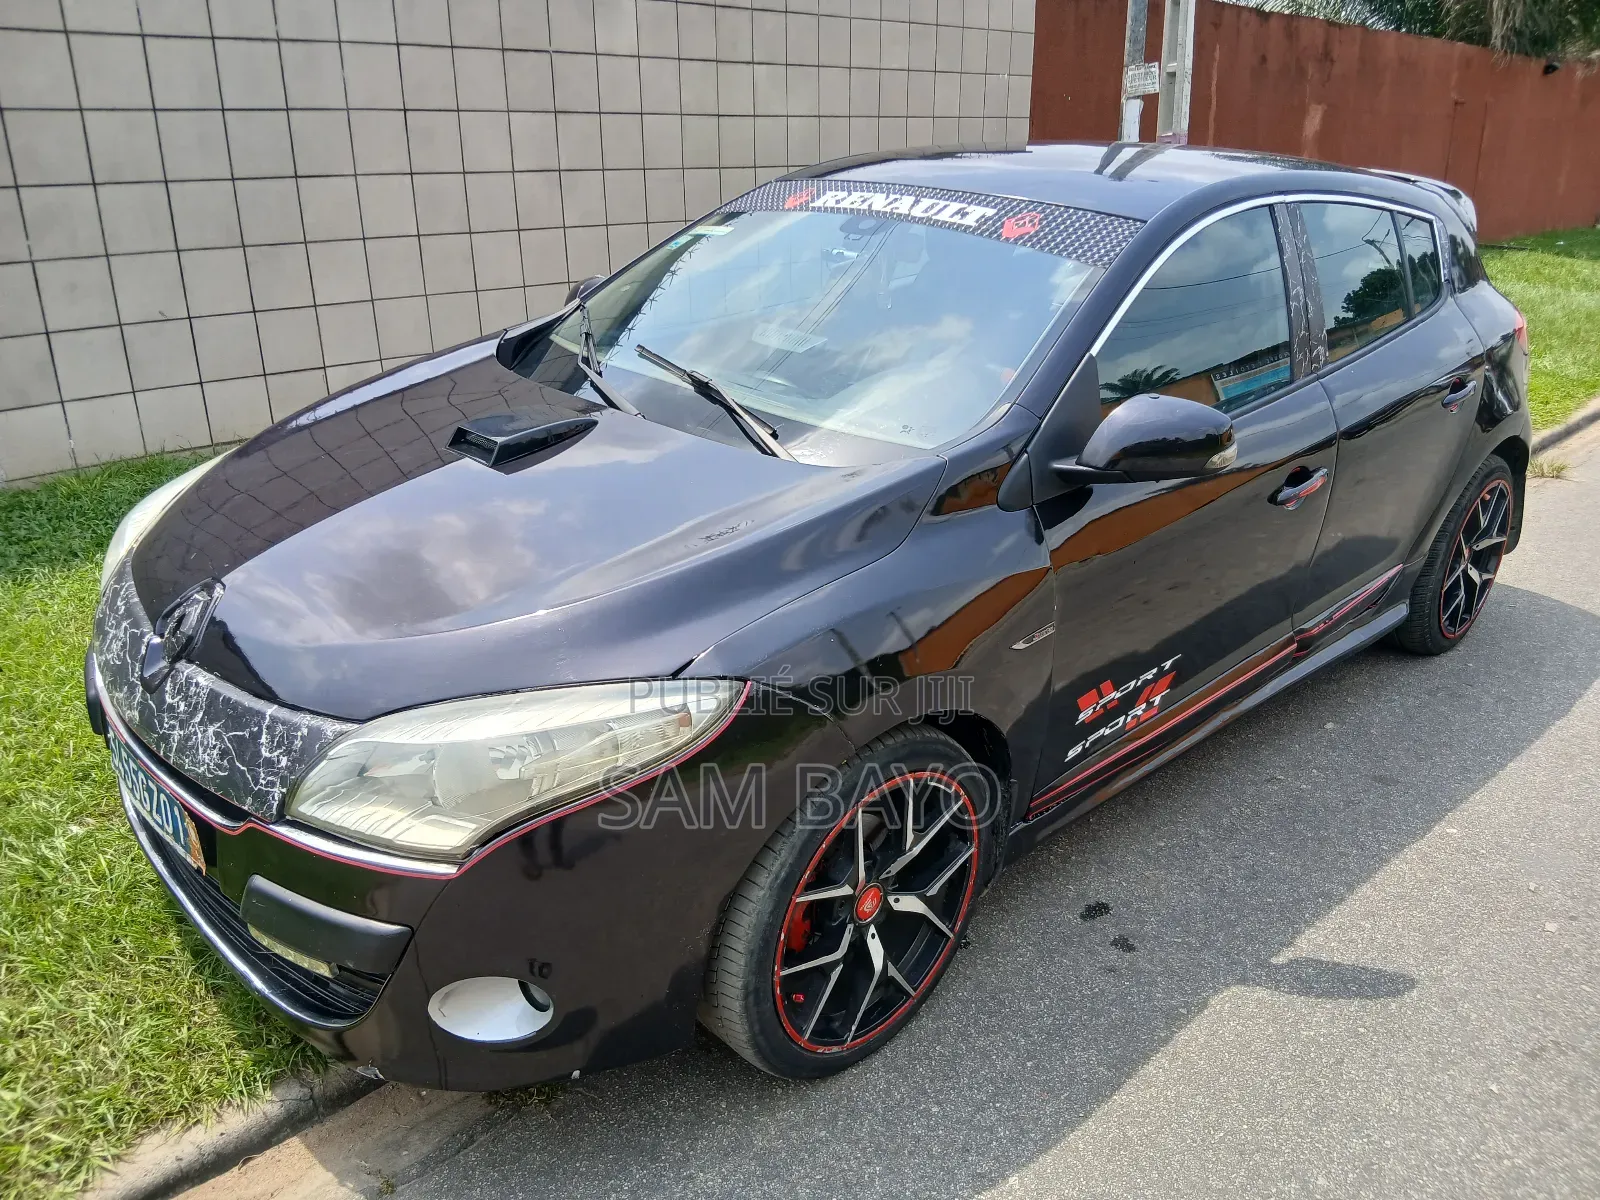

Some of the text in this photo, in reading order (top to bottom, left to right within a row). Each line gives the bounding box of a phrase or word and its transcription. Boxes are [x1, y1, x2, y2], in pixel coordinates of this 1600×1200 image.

[810, 190, 997, 226] RENAULT
[1075, 654, 1182, 725] SPORT
[1064, 689, 1171, 762] SPORT
